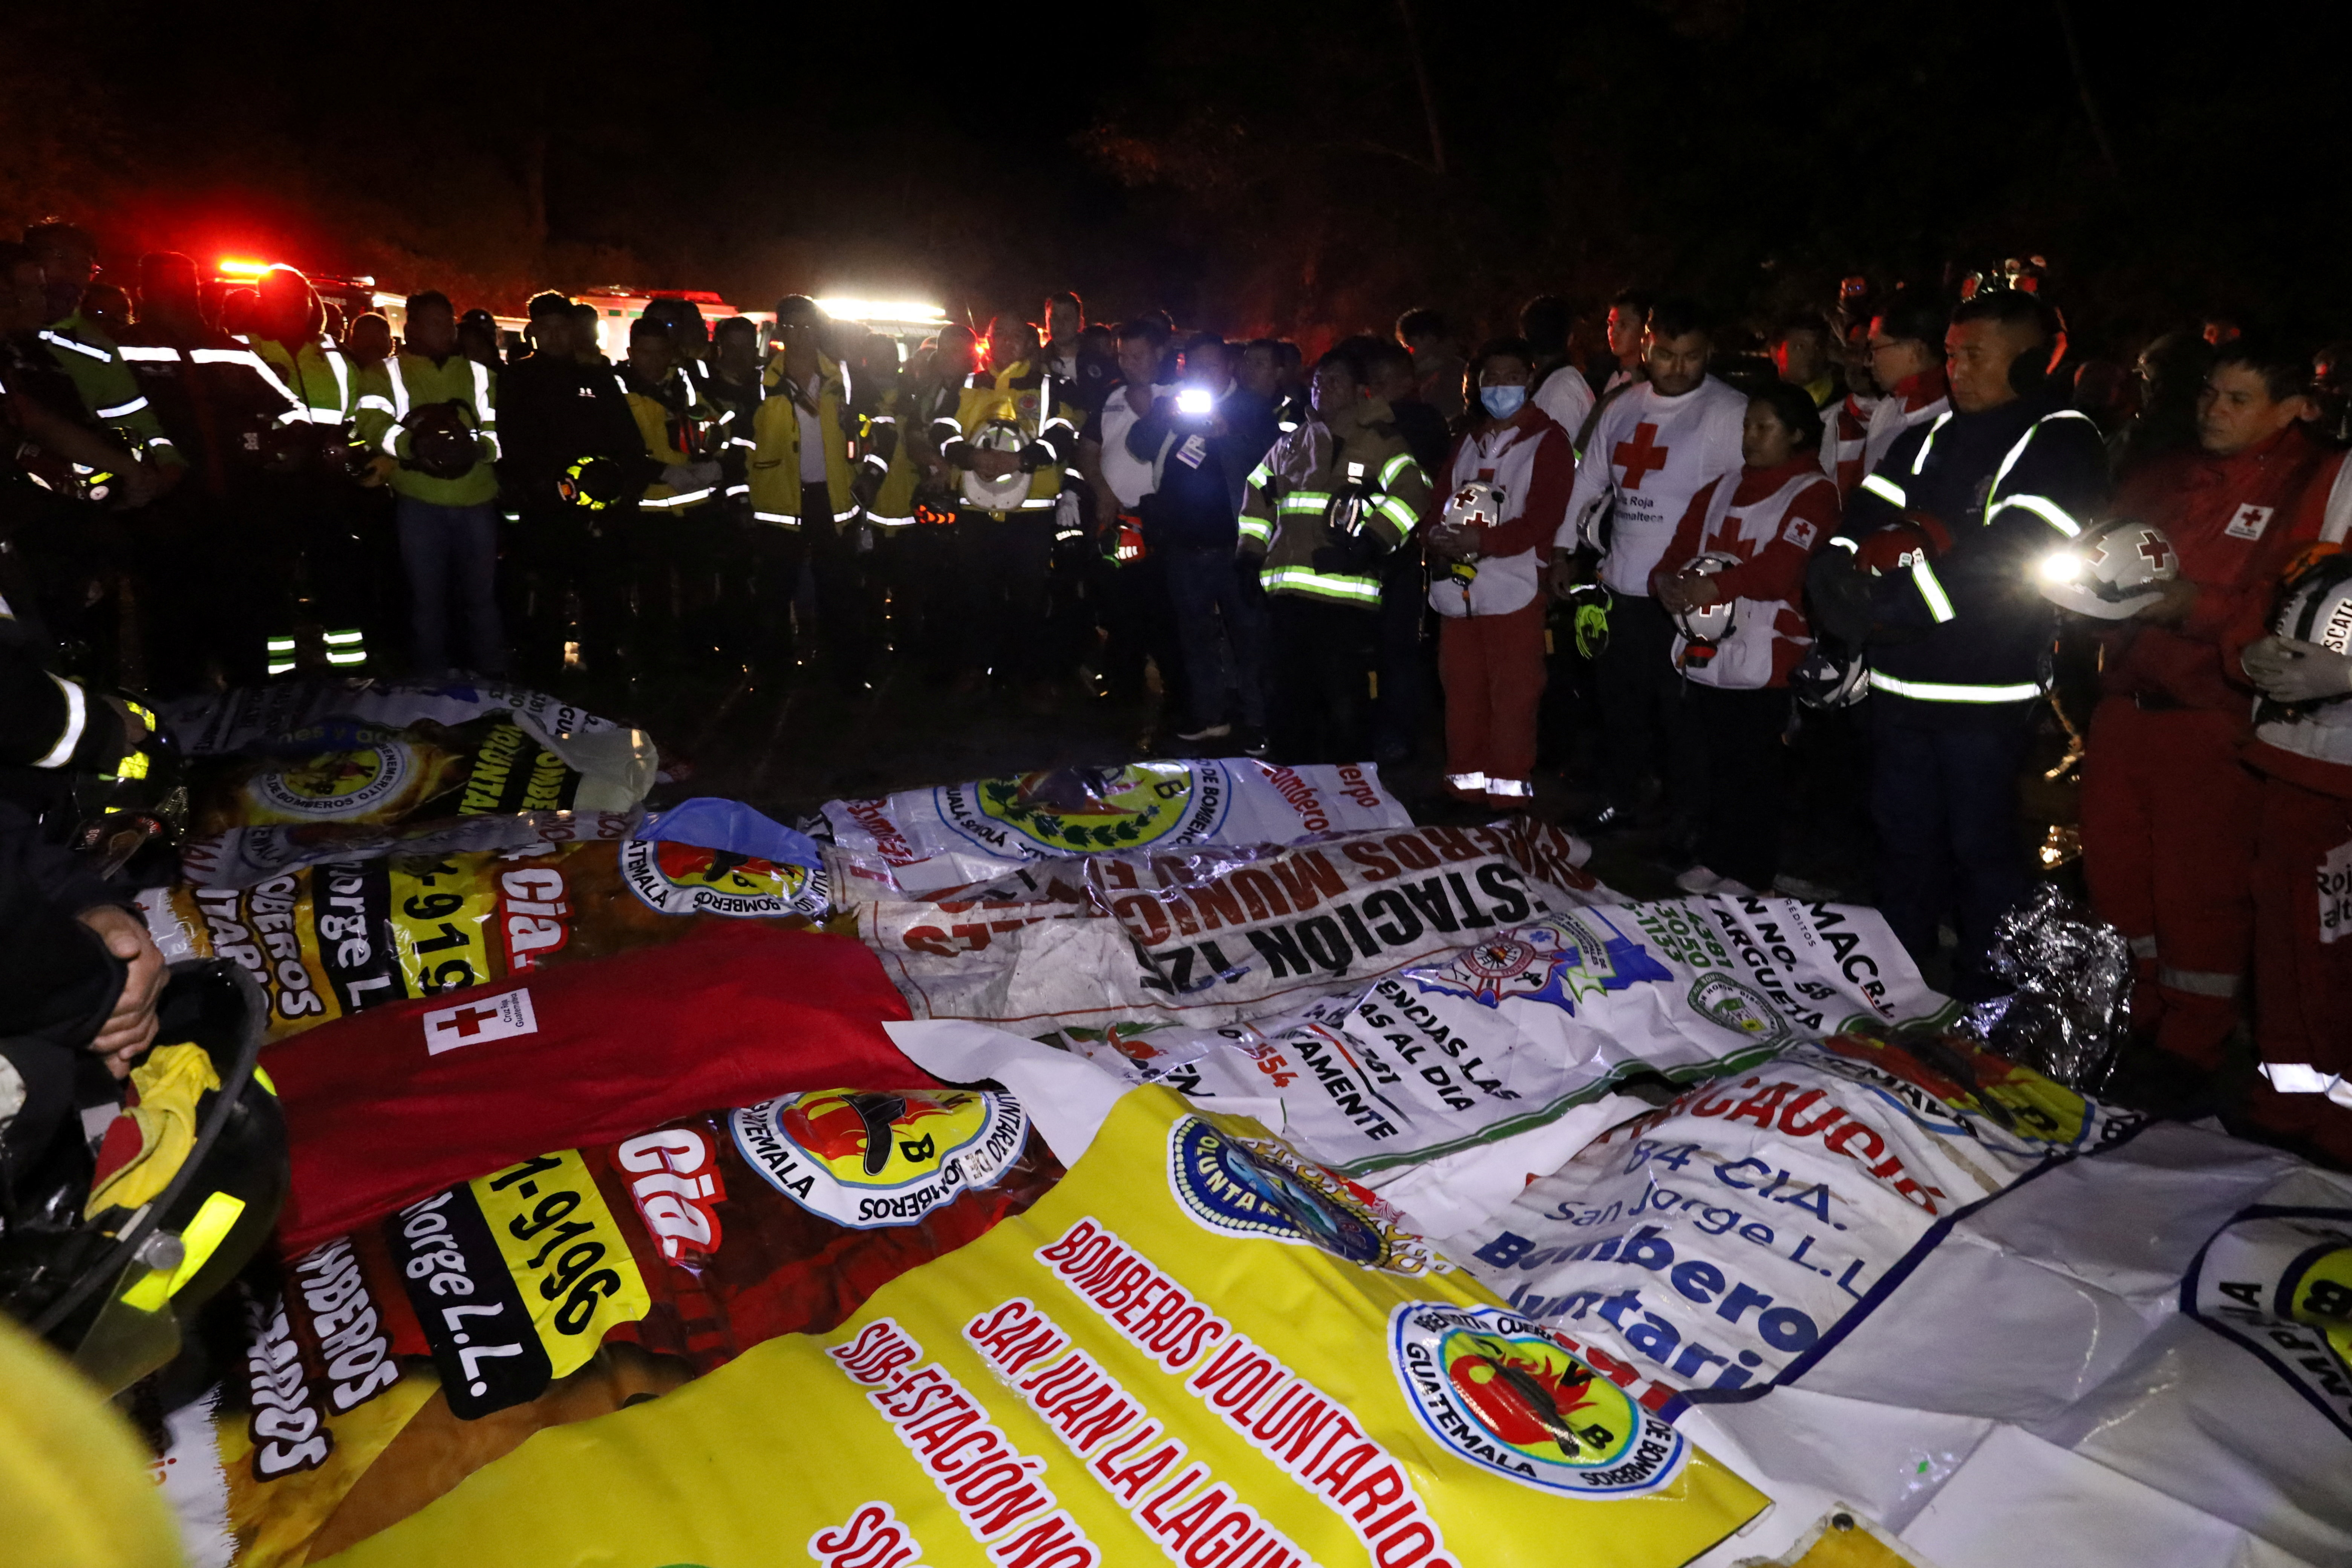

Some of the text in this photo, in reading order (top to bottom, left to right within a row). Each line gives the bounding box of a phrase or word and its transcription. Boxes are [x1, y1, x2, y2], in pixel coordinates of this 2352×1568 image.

[457, 724, 524, 815] VOLUNTA
[628, 839, 669, 908] ATEMALA
[2318, 864, 2352, 894] Roj
[1245, 862, 1551, 979] STACIÓN
[1377, 979, 1468, 1058] ENCIAS
[1383, 1034, 1426, 1065] AL
[858, 1157, 968, 1222] BOMBEROS
[1623, 1140, 1701, 1175] 84
[1544, 1200, 1622, 1227] San
[1628, 1179, 1774, 1247] Jorge
[1041, 1221, 1225, 1367] BOMBEROS
[969, 1302, 1063, 1375] SAN
[1019, 1354, 1138, 1452] JUAN
[1095, 1425, 1180, 1501] LA
[1406, 1342, 1537, 1477] GUATEMALA
